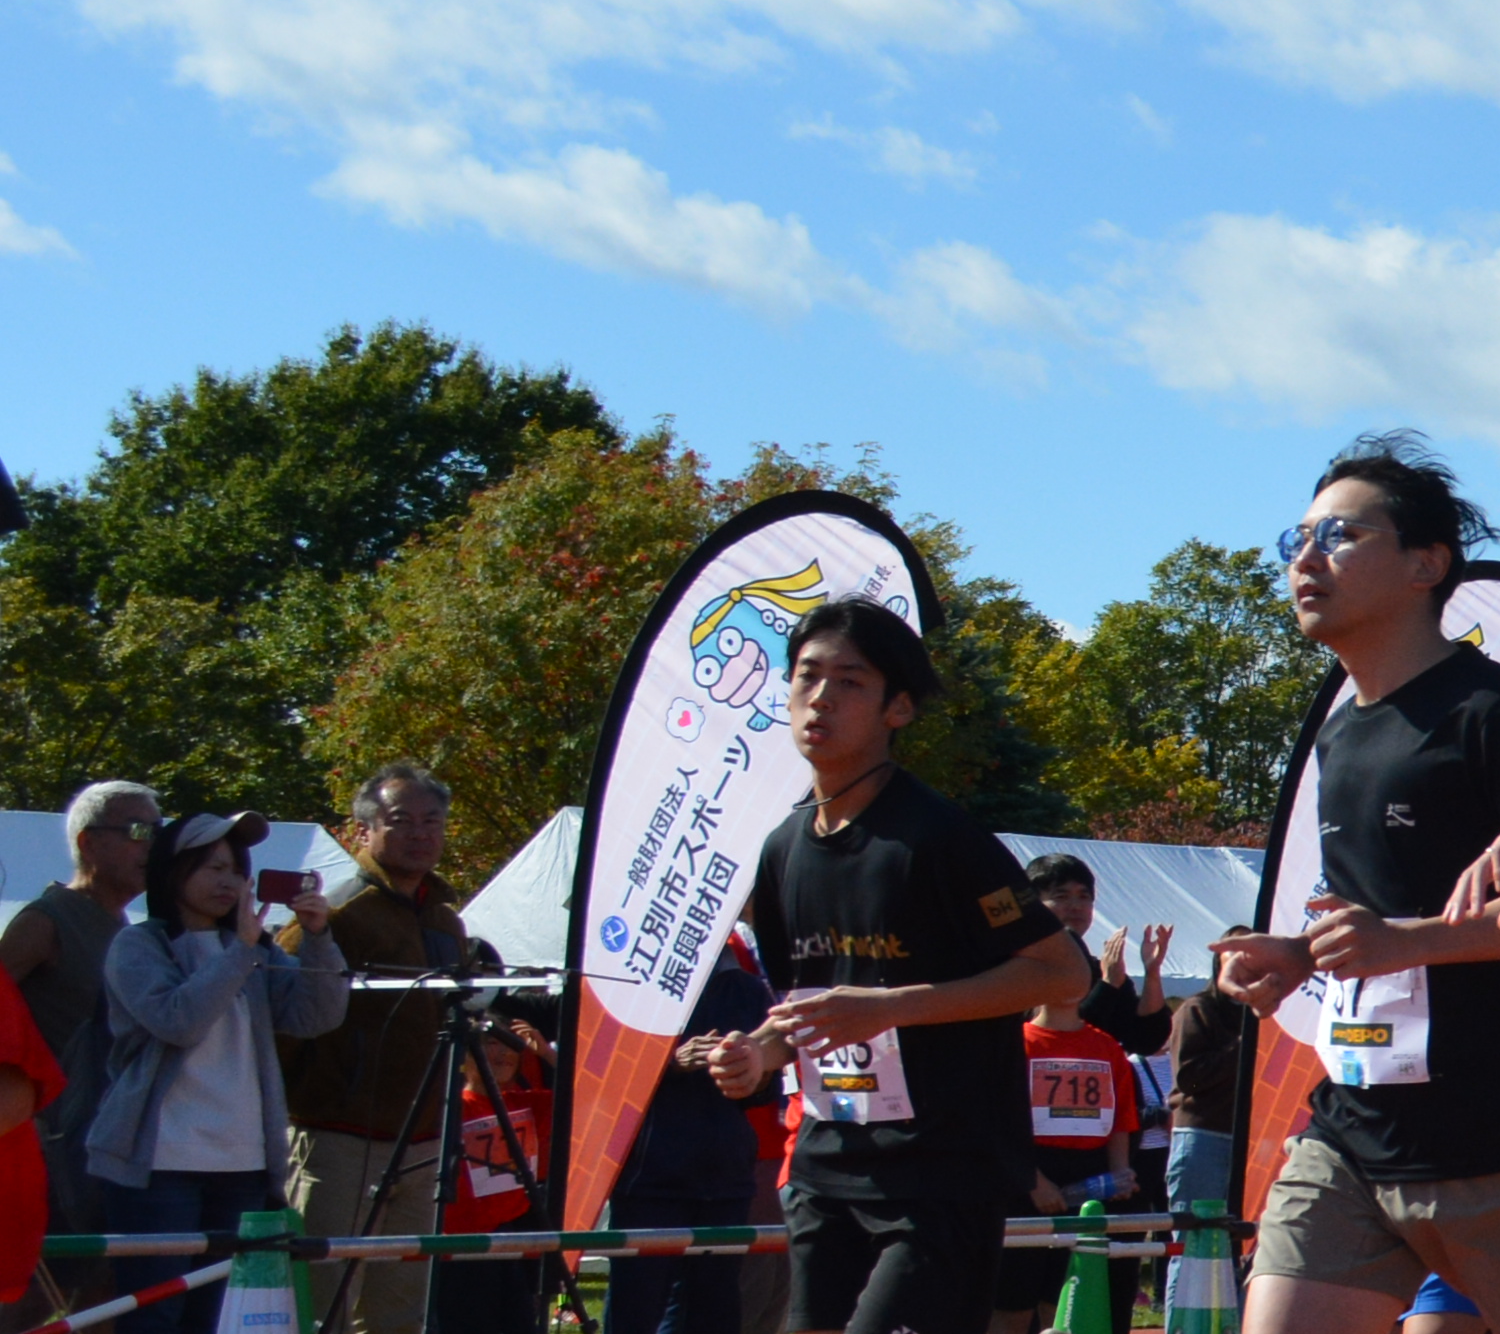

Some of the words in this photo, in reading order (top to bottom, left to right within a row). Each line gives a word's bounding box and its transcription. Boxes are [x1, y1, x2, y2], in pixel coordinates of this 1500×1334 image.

[621, 766, 699, 908] 一般財団法人
[625, 733, 751, 985] 江別市スポーツ
[658, 851, 740, 1002] 振興財団
[1044, 1075, 1100, 1106] 718
